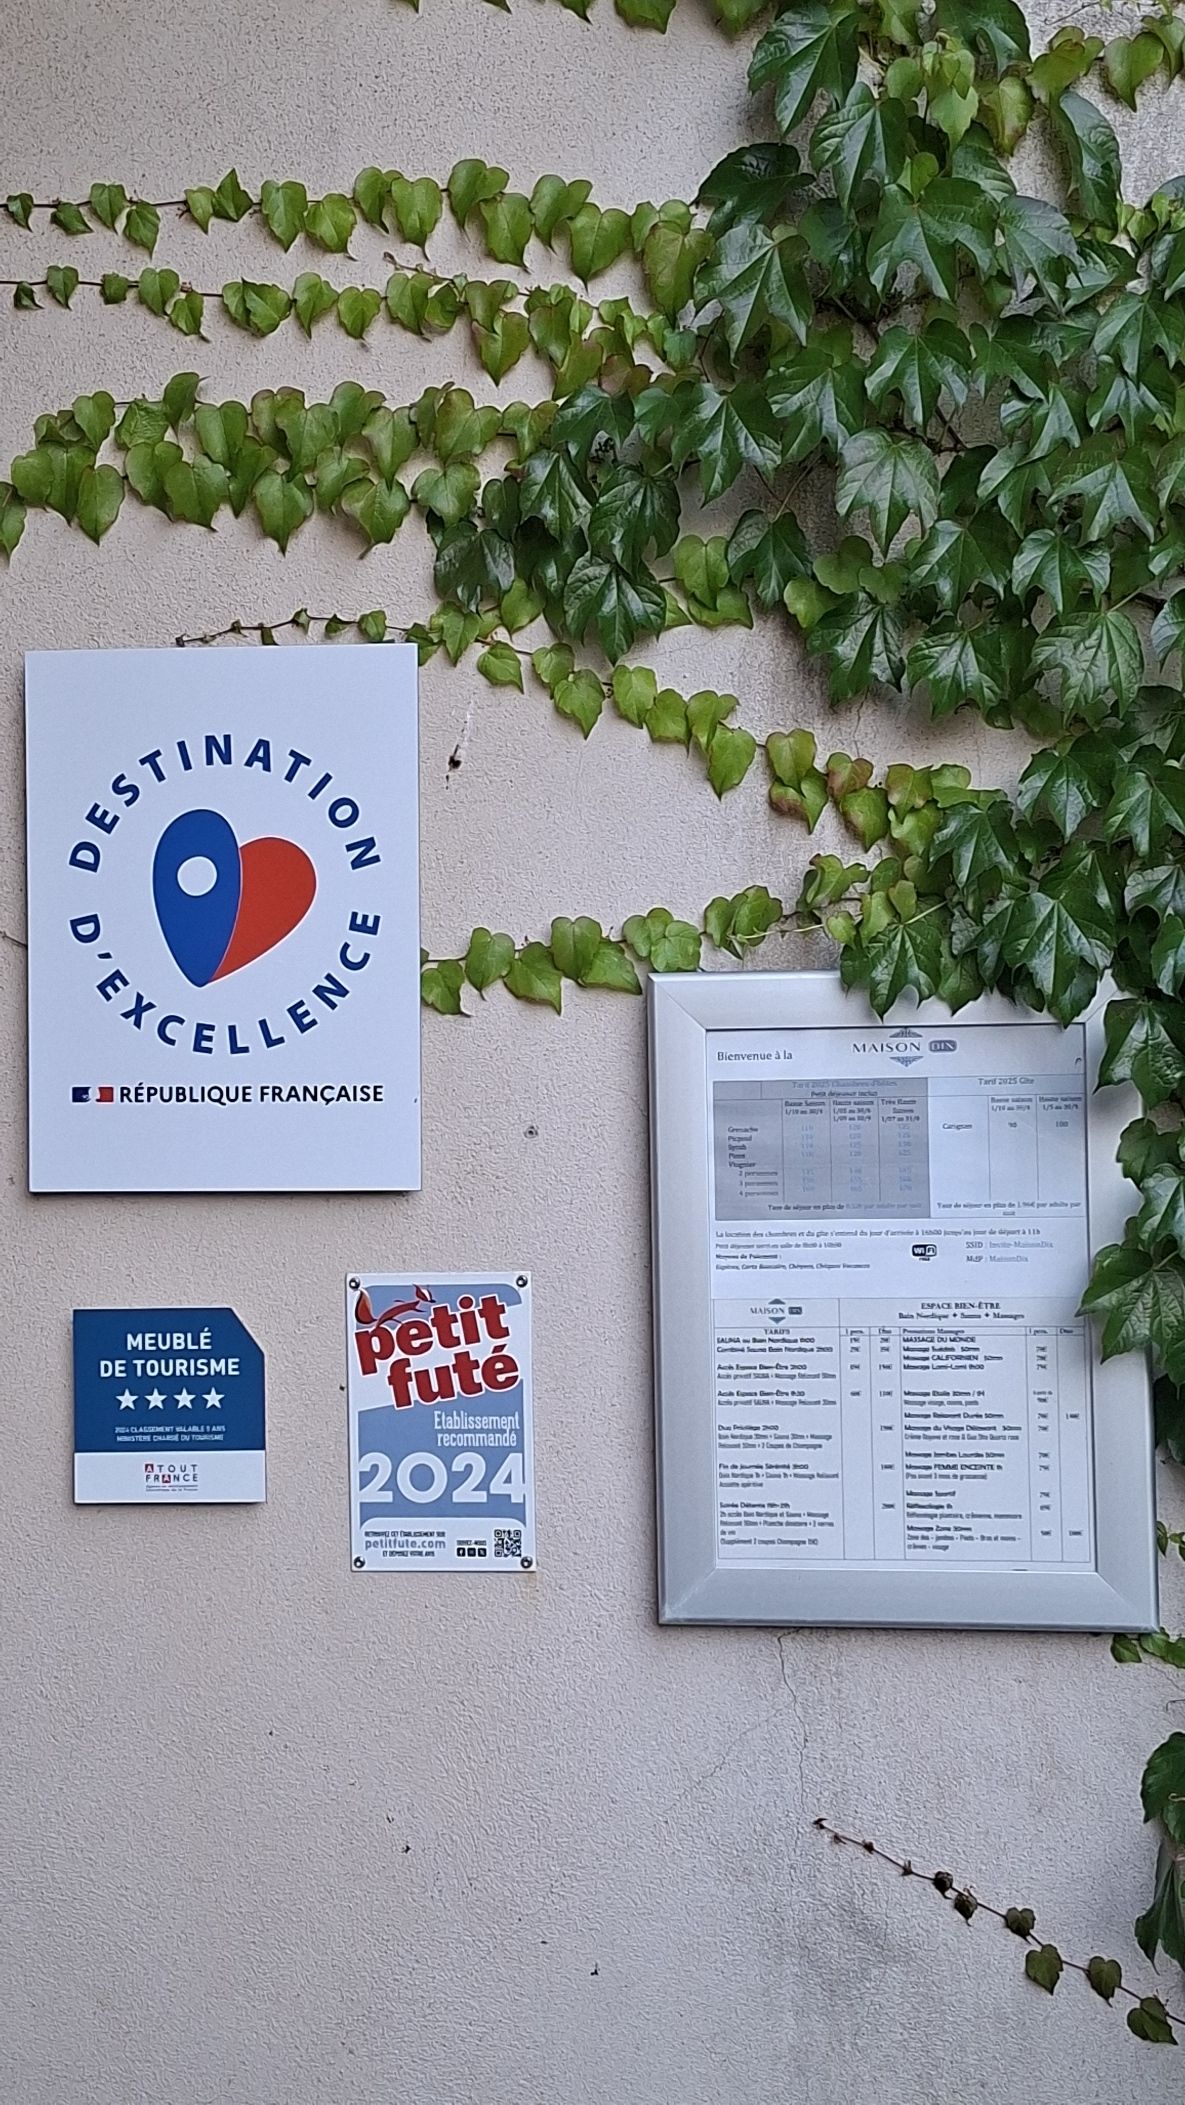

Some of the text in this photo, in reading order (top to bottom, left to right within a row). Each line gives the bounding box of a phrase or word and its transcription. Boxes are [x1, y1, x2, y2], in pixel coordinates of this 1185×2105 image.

[69, 733, 382, 873] DESTINATION
[717, 1050, 792, 1061] Bienvenue à la
[852, 1042, 921, 1053] MAISON
[120, 1082, 384, 1106] RÉPUBLIQUE FRANÇAISE
[955, 1301, 1001, 1309] BIEN-ÊTRE
[126, 1327, 212, 1351] MEUBLÉ
[354, 1295, 510, 1376] petit
[100, 1358, 240, 1377] DE TOURISME
[388, 1344, 519, 1408] futé
[434, 1411, 519, 1430] Etablissement
[437, 1428, 517, 1447] recommandé
[146, 1474, 198, 1483] FRANCE
[359, 1452, 525, 1503] 2024
[365, 1537, 446, 1550] petitfute.com
